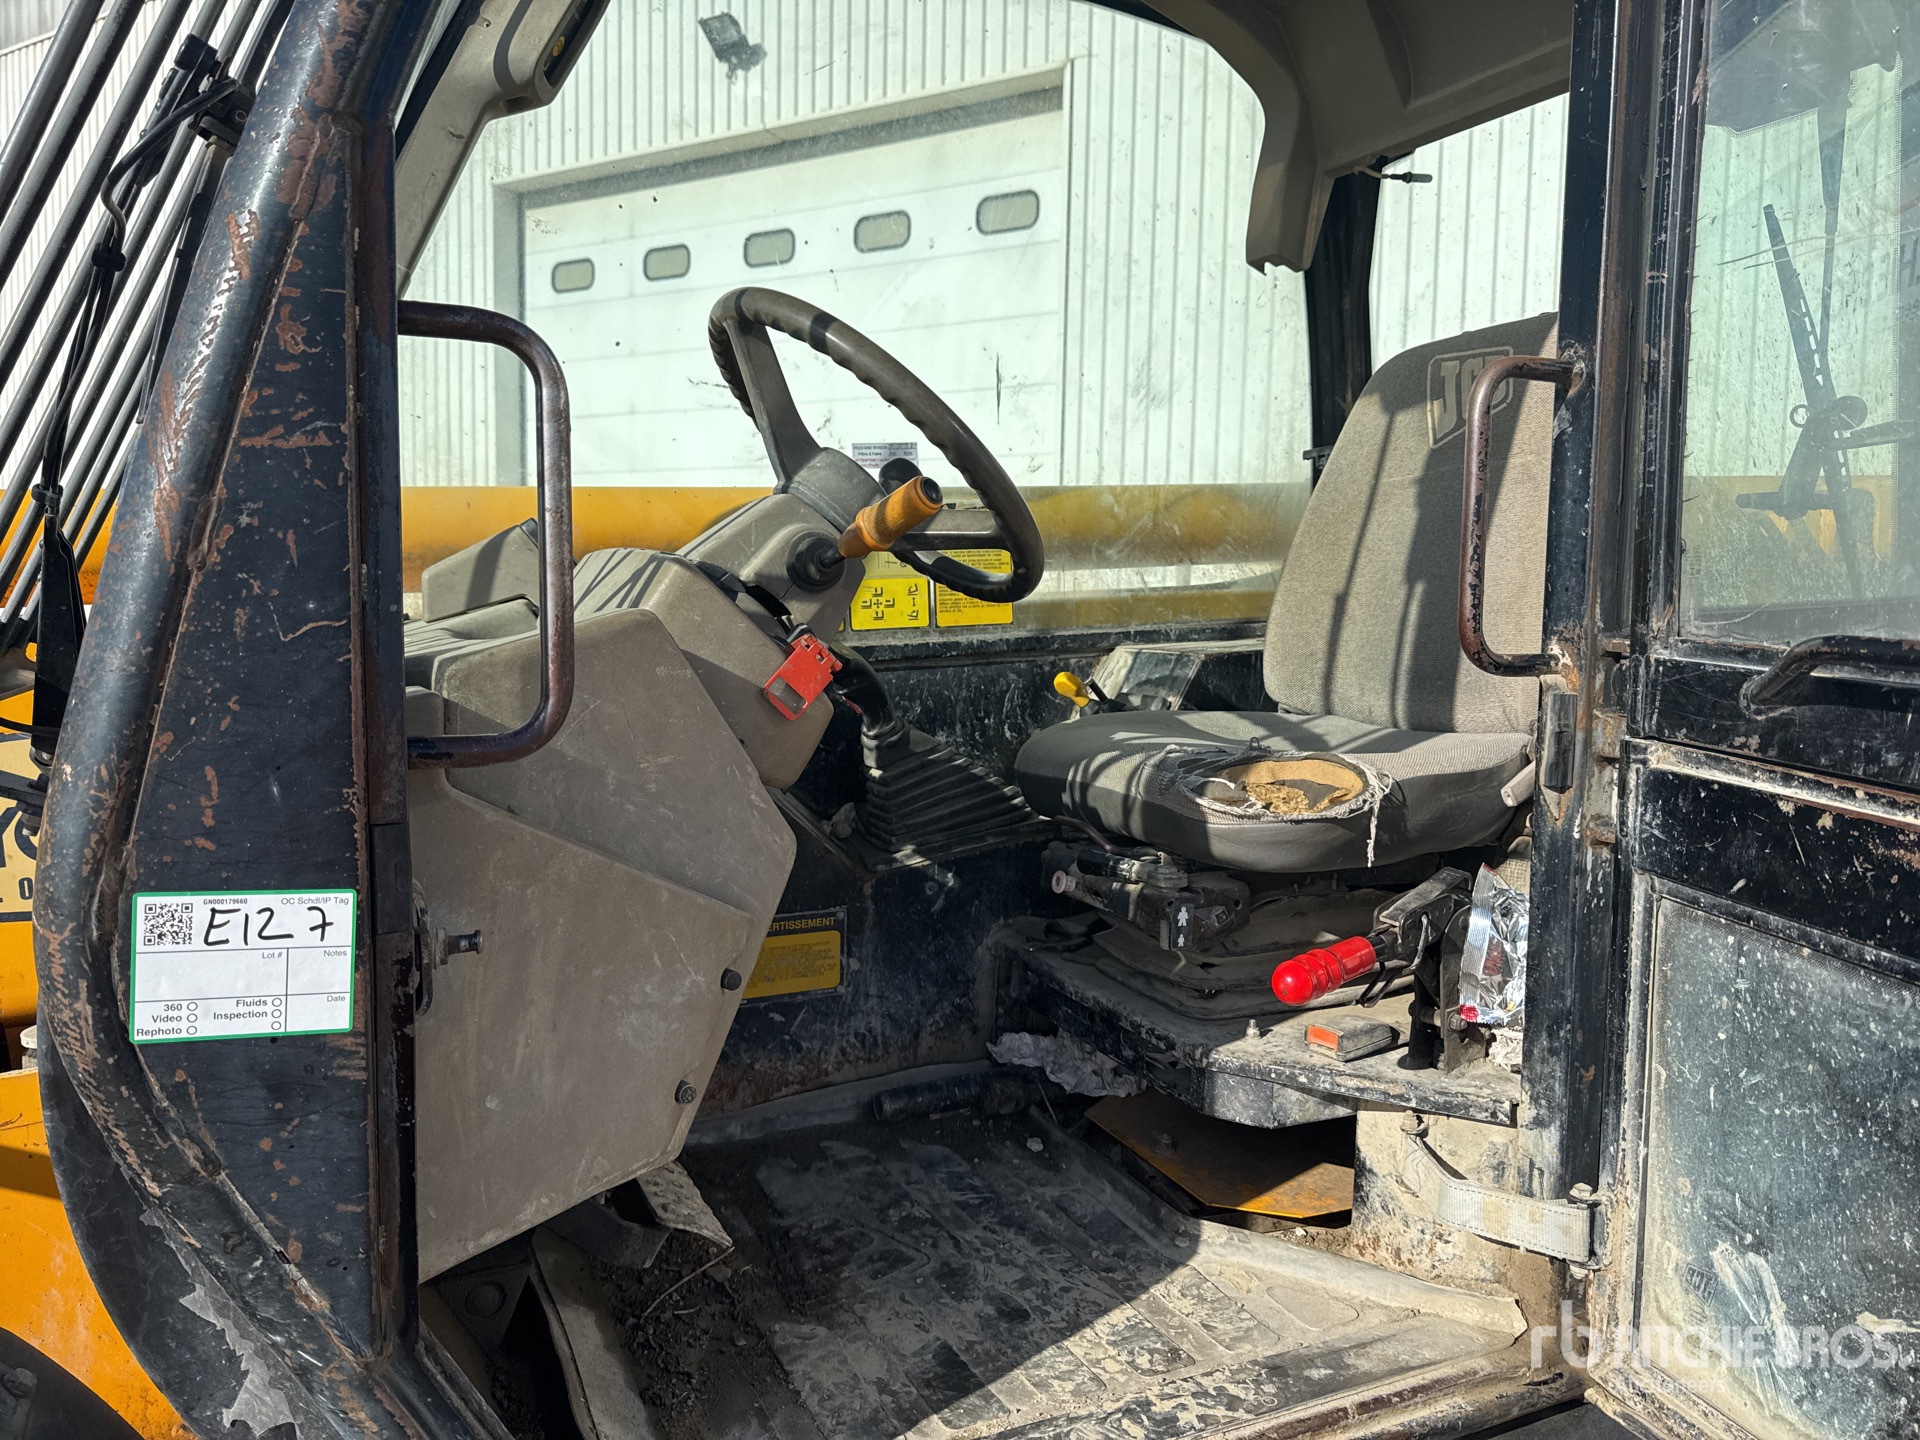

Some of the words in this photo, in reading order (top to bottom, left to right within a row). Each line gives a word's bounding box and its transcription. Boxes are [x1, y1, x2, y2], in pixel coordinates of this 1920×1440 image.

[281, 897, 296, 905] OC
[333, 896, 349, 906] Tag
[262, 951, 276, 959] Lot
[323, 949, 347, 957] Notes
[236, 998, 268, 1008] Fluids
[326, 994, 346, 1003] Date
[163, 1003, 183, 1012] 360
[151, 1014, 183, 1023] Video
[213, 1010, 268, 1021] Inspection
[136, 1026, 182, 1037] Rephoto
